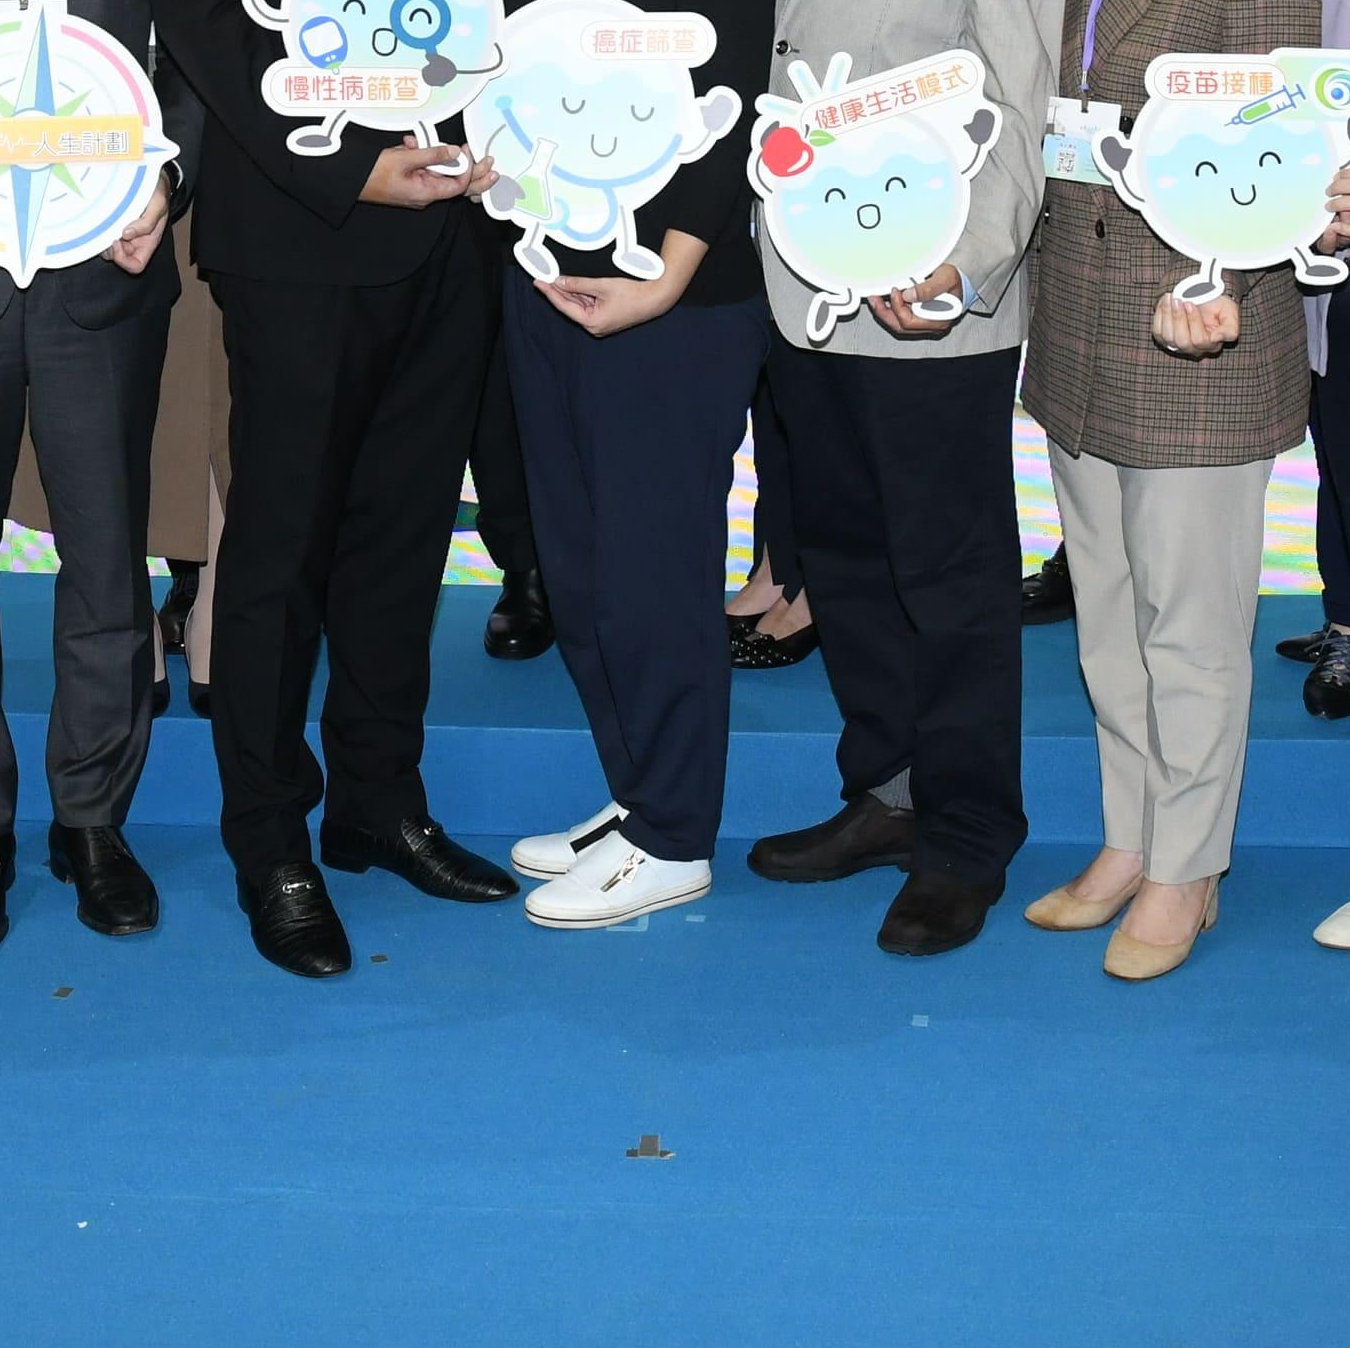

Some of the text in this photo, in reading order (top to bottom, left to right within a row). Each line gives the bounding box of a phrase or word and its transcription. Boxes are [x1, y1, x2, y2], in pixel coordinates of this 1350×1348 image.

[591, 28, 699, 55] 癌症篩查
[283, 75, 420, 103] 慢性病篩查
[1166, 70, 1275, 96] 疫苗接種
[812, 63, 971, 131] 健康生活模式
[34, 130, 131, 157] 人生計劃
